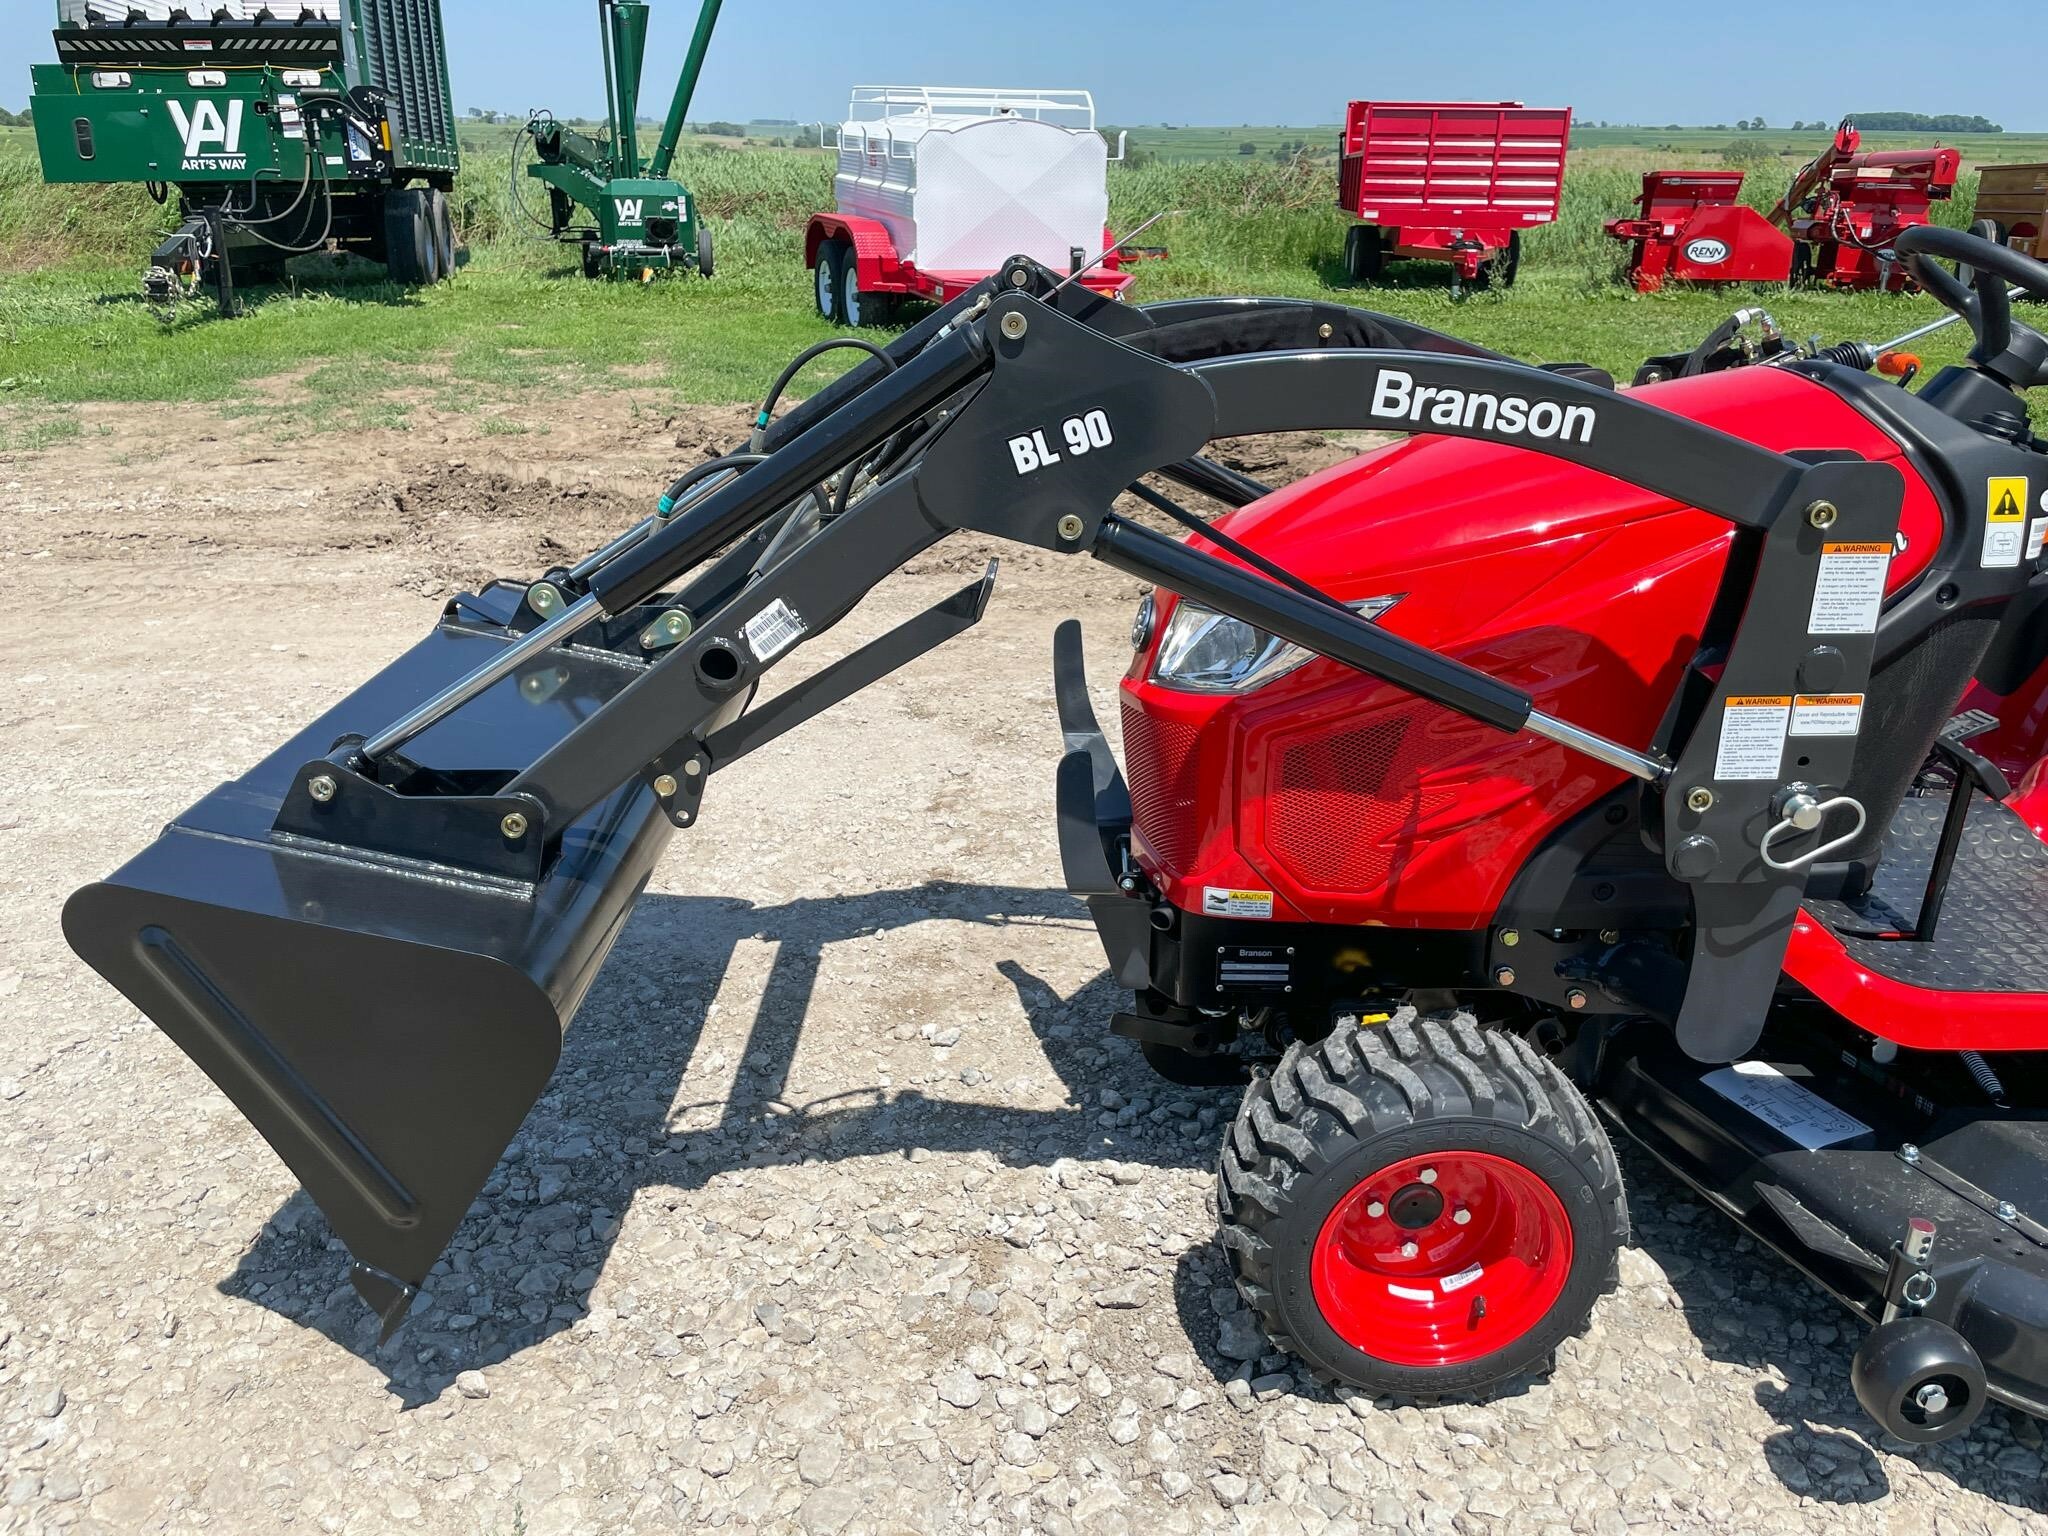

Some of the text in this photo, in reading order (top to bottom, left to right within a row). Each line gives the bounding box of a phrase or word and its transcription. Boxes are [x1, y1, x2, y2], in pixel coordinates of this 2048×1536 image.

[181, 158, 247, 170] ART'S WAY
[1690, 246, 1723, 258] RENN
[1370, 368, 1596, 443] Branson
[1008, 409, 1113, 475] BL 90
[1843, 544, 1881, 552] WARNING
[1239, 949, 1273, 957] Branson
